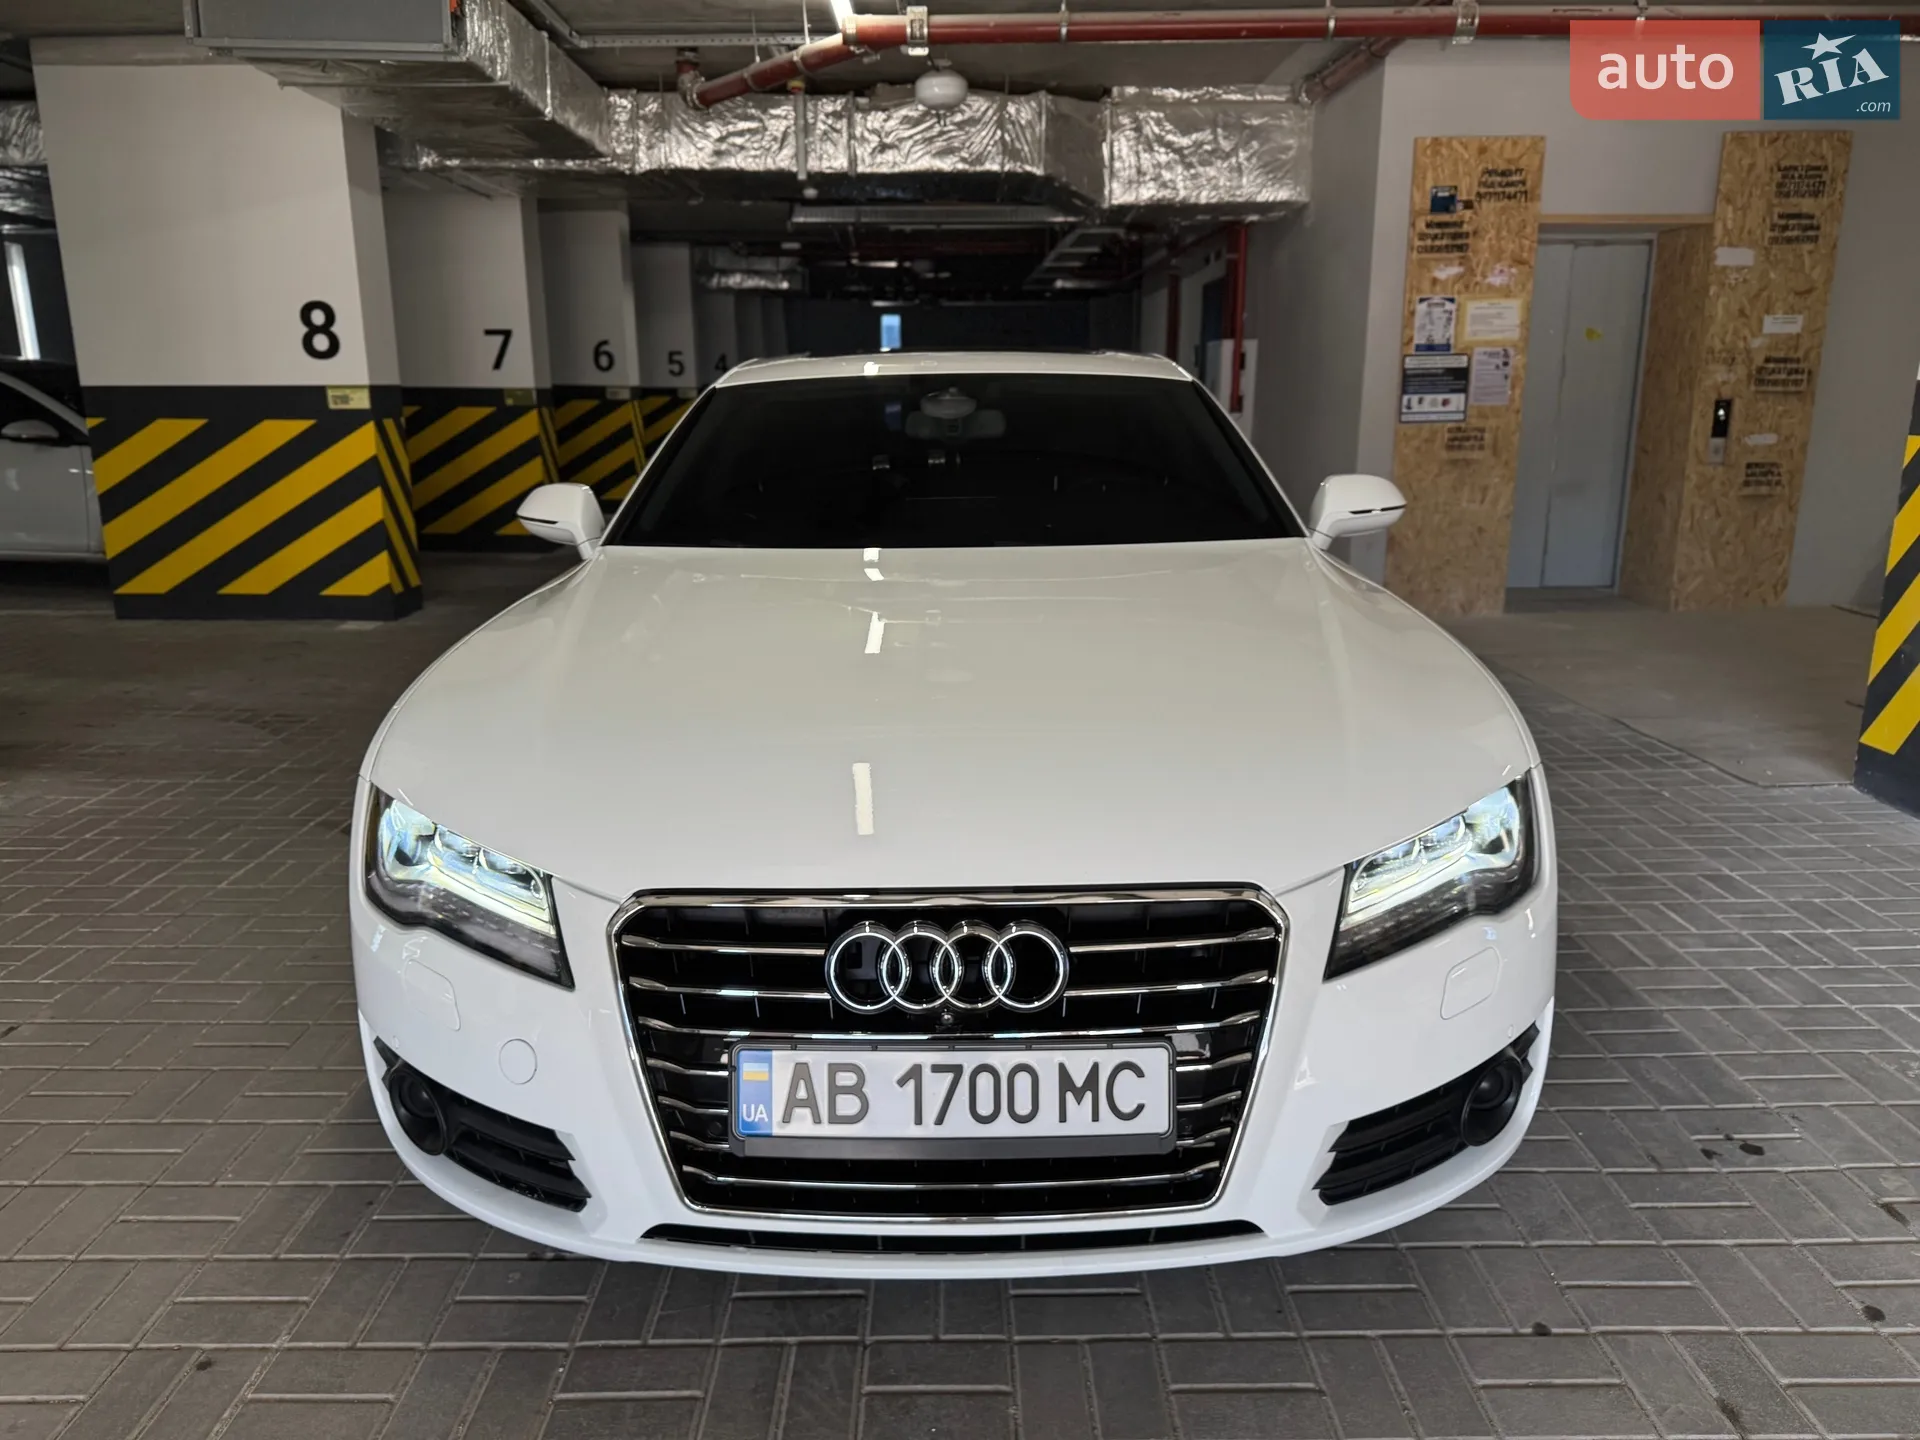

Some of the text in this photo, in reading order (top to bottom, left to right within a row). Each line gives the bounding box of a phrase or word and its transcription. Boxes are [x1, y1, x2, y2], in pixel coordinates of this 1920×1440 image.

[299, 300, 341, 360] 8
[483, 329, 513, 371] 7
[592, 340, 615, 372] 6
[667, 351, 685, 377] 5
[714, 352, 728, 373] 4
[781, 1060, 1146, 1126] AB 1700 MC
[741, 1104, 769, 1123] UA
